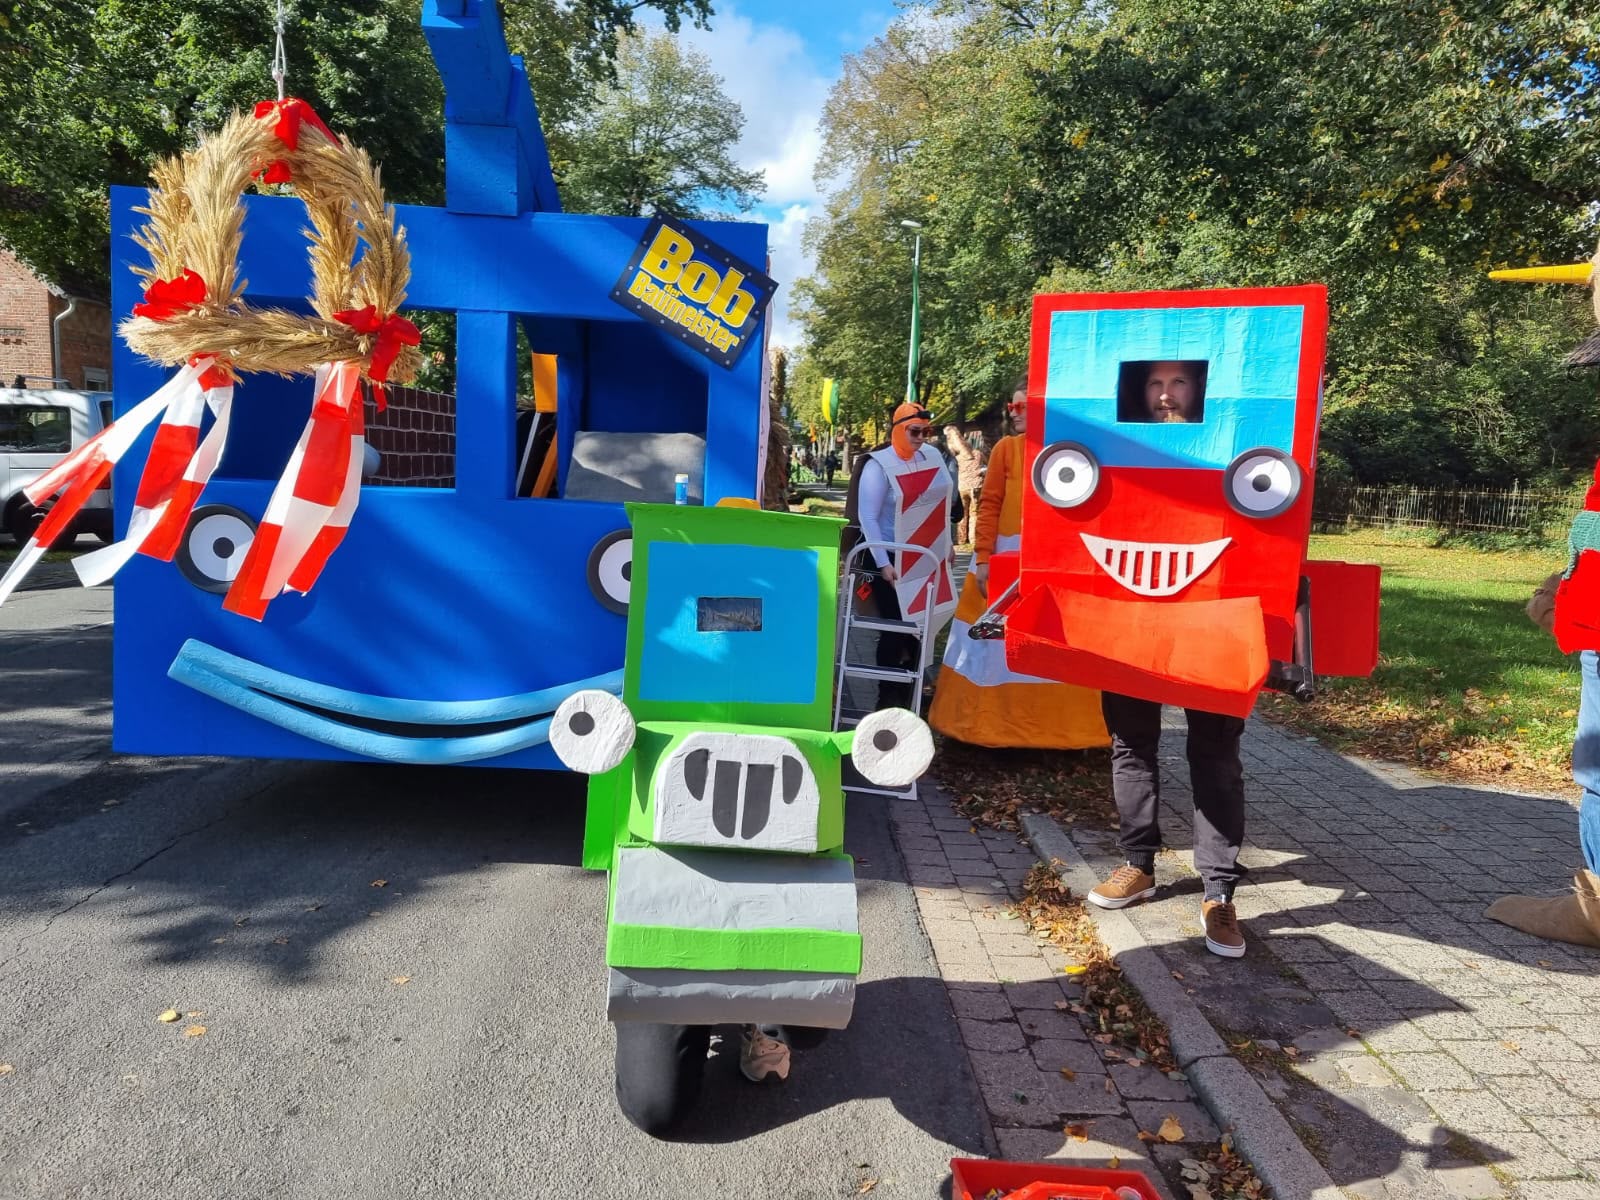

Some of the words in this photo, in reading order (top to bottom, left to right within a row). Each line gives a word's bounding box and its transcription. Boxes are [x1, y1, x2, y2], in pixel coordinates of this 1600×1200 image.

[628, 271, 740, 353] Baumeister
[640, 224, 755, 328] Bob
[664, 284, 683, 298] der
